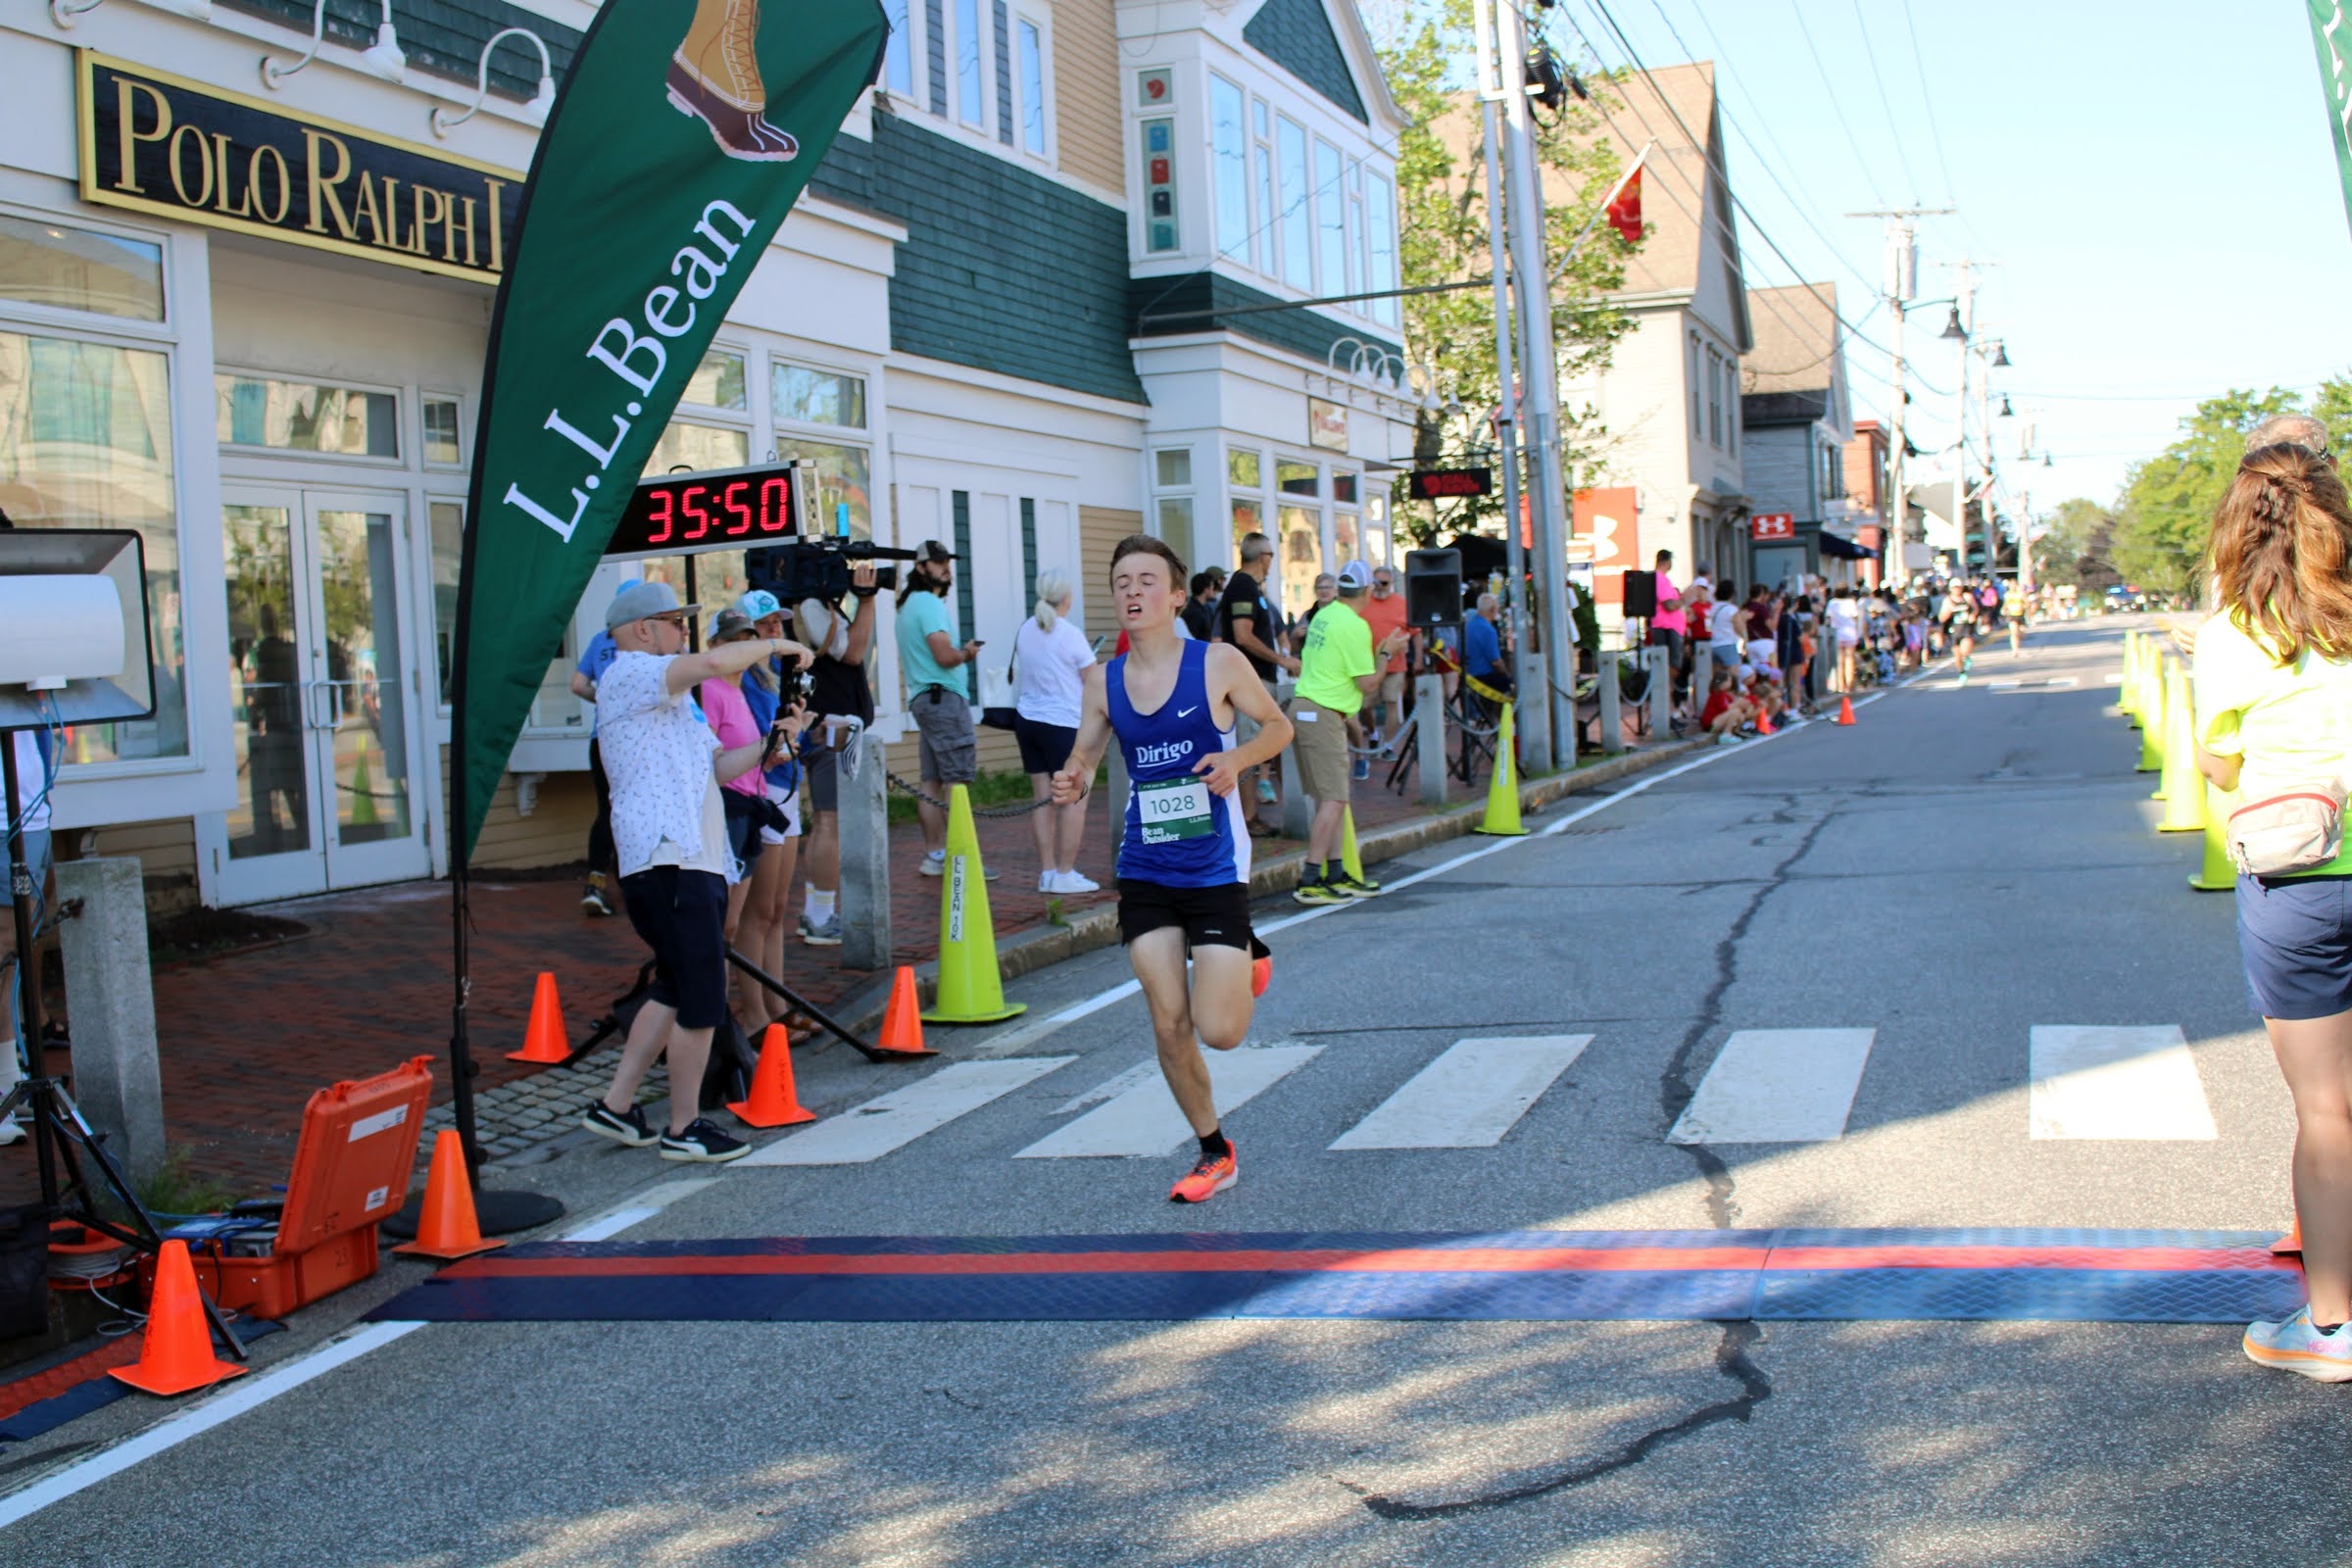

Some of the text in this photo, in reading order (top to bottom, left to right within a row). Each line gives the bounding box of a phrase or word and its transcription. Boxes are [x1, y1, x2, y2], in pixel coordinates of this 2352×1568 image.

[112, 75, 290, 224] POLO
[301, 127, 479, 266] RALPH
[503, 199, 757, 544] L.L.Bean
[648, 478, 788, 543] 35:50
[1135, 740, 1193, 765] Dirigo
[1151, 795, 1196, 814] 1028
[1142, 826, 1164, 836] Bean
[1143, 833, 1180, 845] Outsider
[953, 877, 961, 911] BEAN
